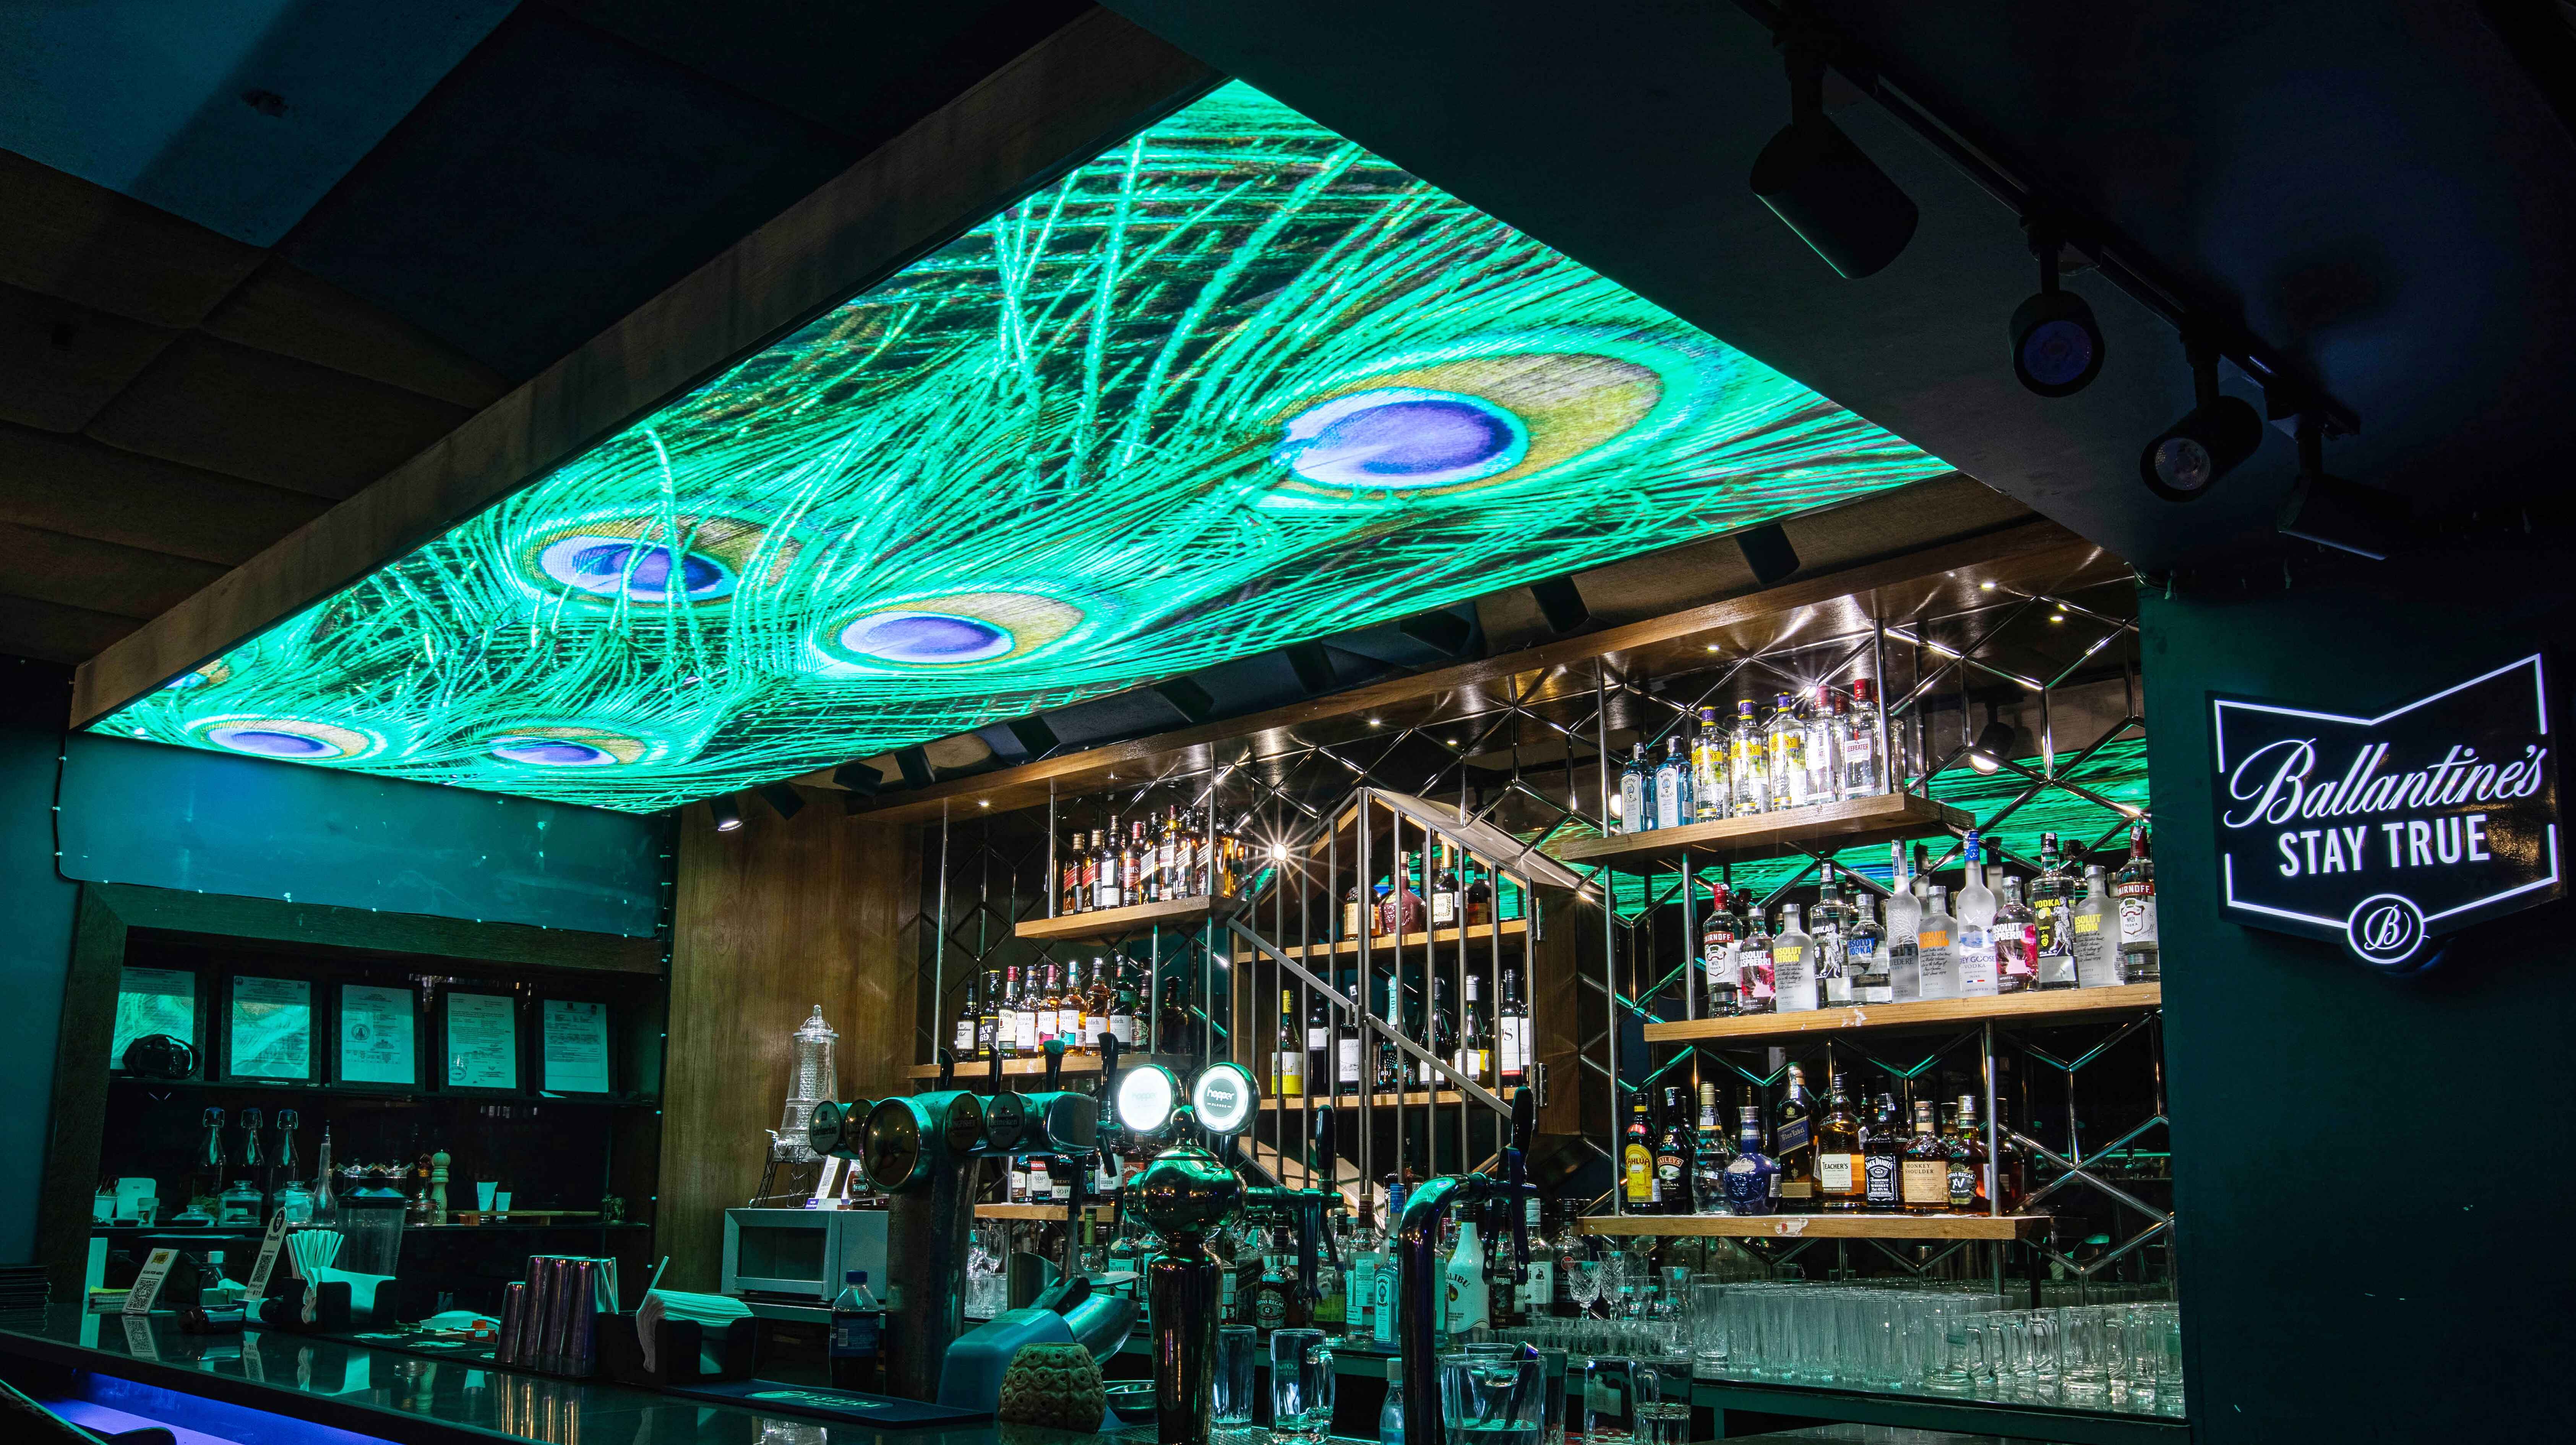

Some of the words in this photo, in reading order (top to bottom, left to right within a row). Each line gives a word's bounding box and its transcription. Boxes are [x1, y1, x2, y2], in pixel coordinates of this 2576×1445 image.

[2224, 738, 2547, 828] Ballantine's
[2278, 826, 2367, 877] STAY
[2382, 814, 2490, 868] TRUE
[2118, 885, 2151, 895] MIRNOFF
[2034, 899, 2060, 908] VODKA
[1705, 933, 1731, 943] MIRNOFF
[1994, 930, 2025, 942] SPBERRI
[1849, 946, 1872, 955] VODKA
[1775, 954, 1799, 963] CITRON
[1890, 957, 1914, 966] VEDERE
[1207, 1086, 1235, 1101] hopper
[1781, 1133, 1792, 1141] Blue
[1792, 1127, 1805, 1137] Label
[1822, 1162, 1848, 1171] TEACHER'S
[1865, 1160, 1876, 1170] JACK
[1875, 1158, 1893, 1169] DANIEL'S
[1952, 1177, 1965, 1189] XV
[1447, 1273, 1471, 1288] ALIBU
[1493, 1275, 1510, 1285] Morgan
